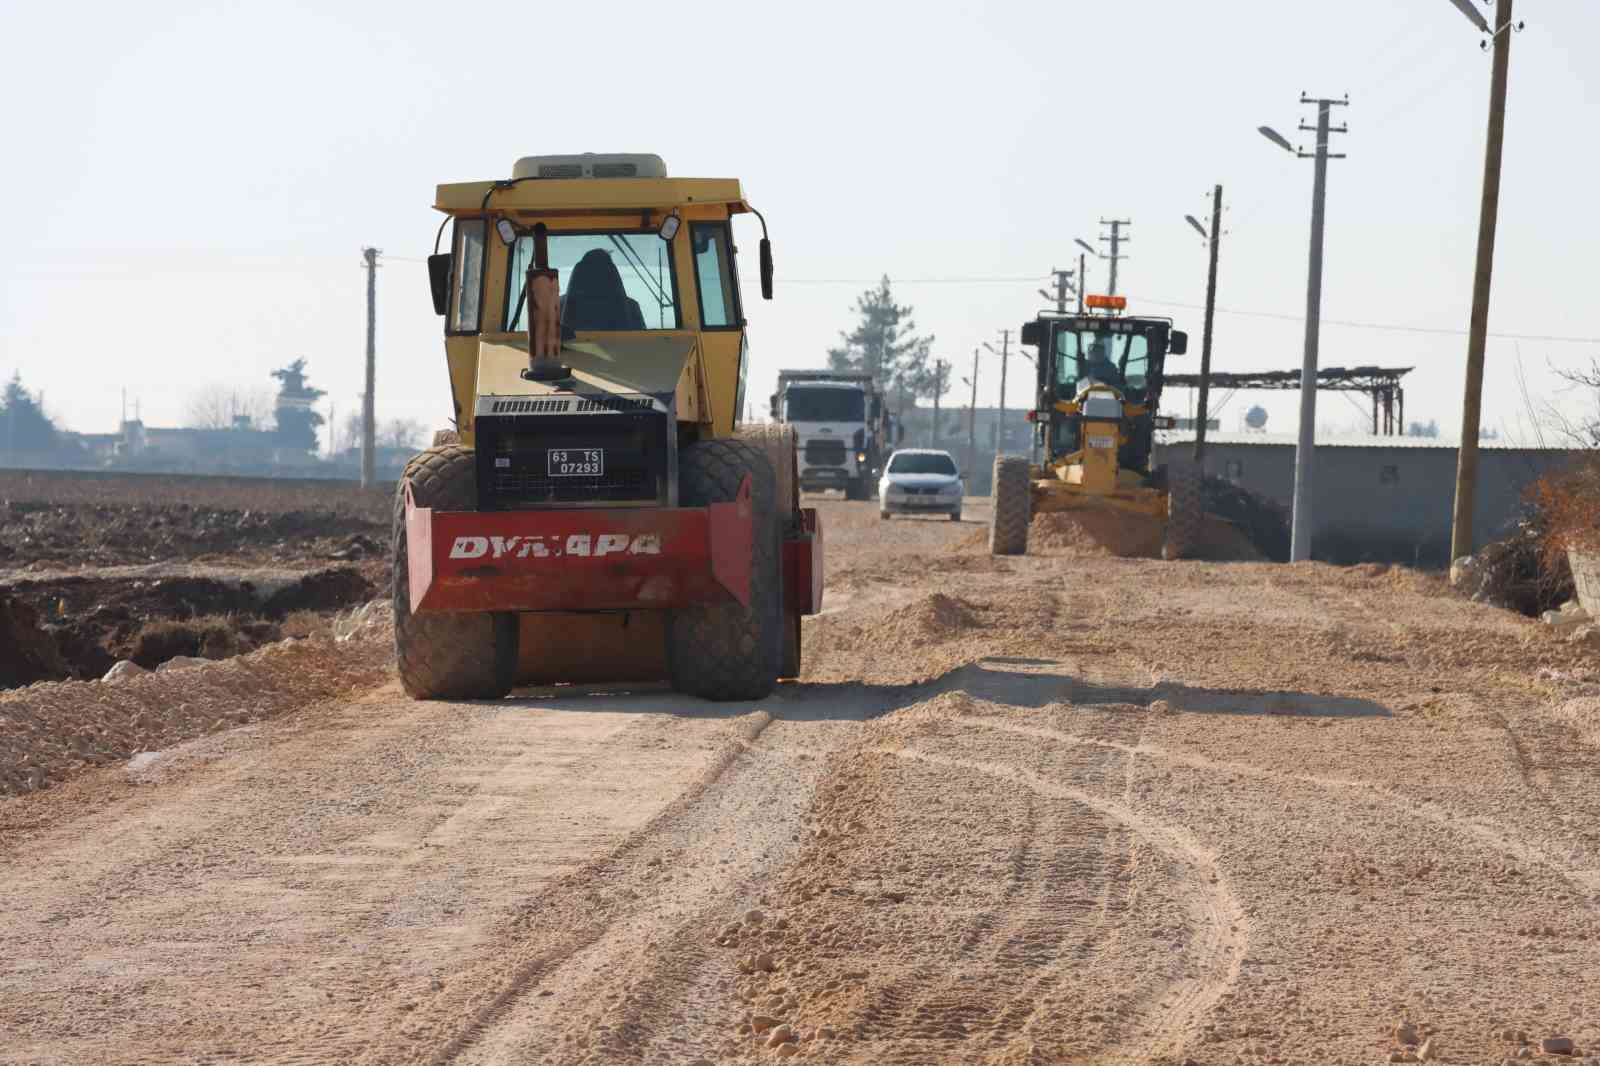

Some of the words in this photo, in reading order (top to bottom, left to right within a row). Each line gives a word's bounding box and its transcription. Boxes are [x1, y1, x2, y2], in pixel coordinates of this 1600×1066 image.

[552, 452, 568, 462] 63
[583, 451, 599, 462] TS
[560, 462, 599, 473] 07293
